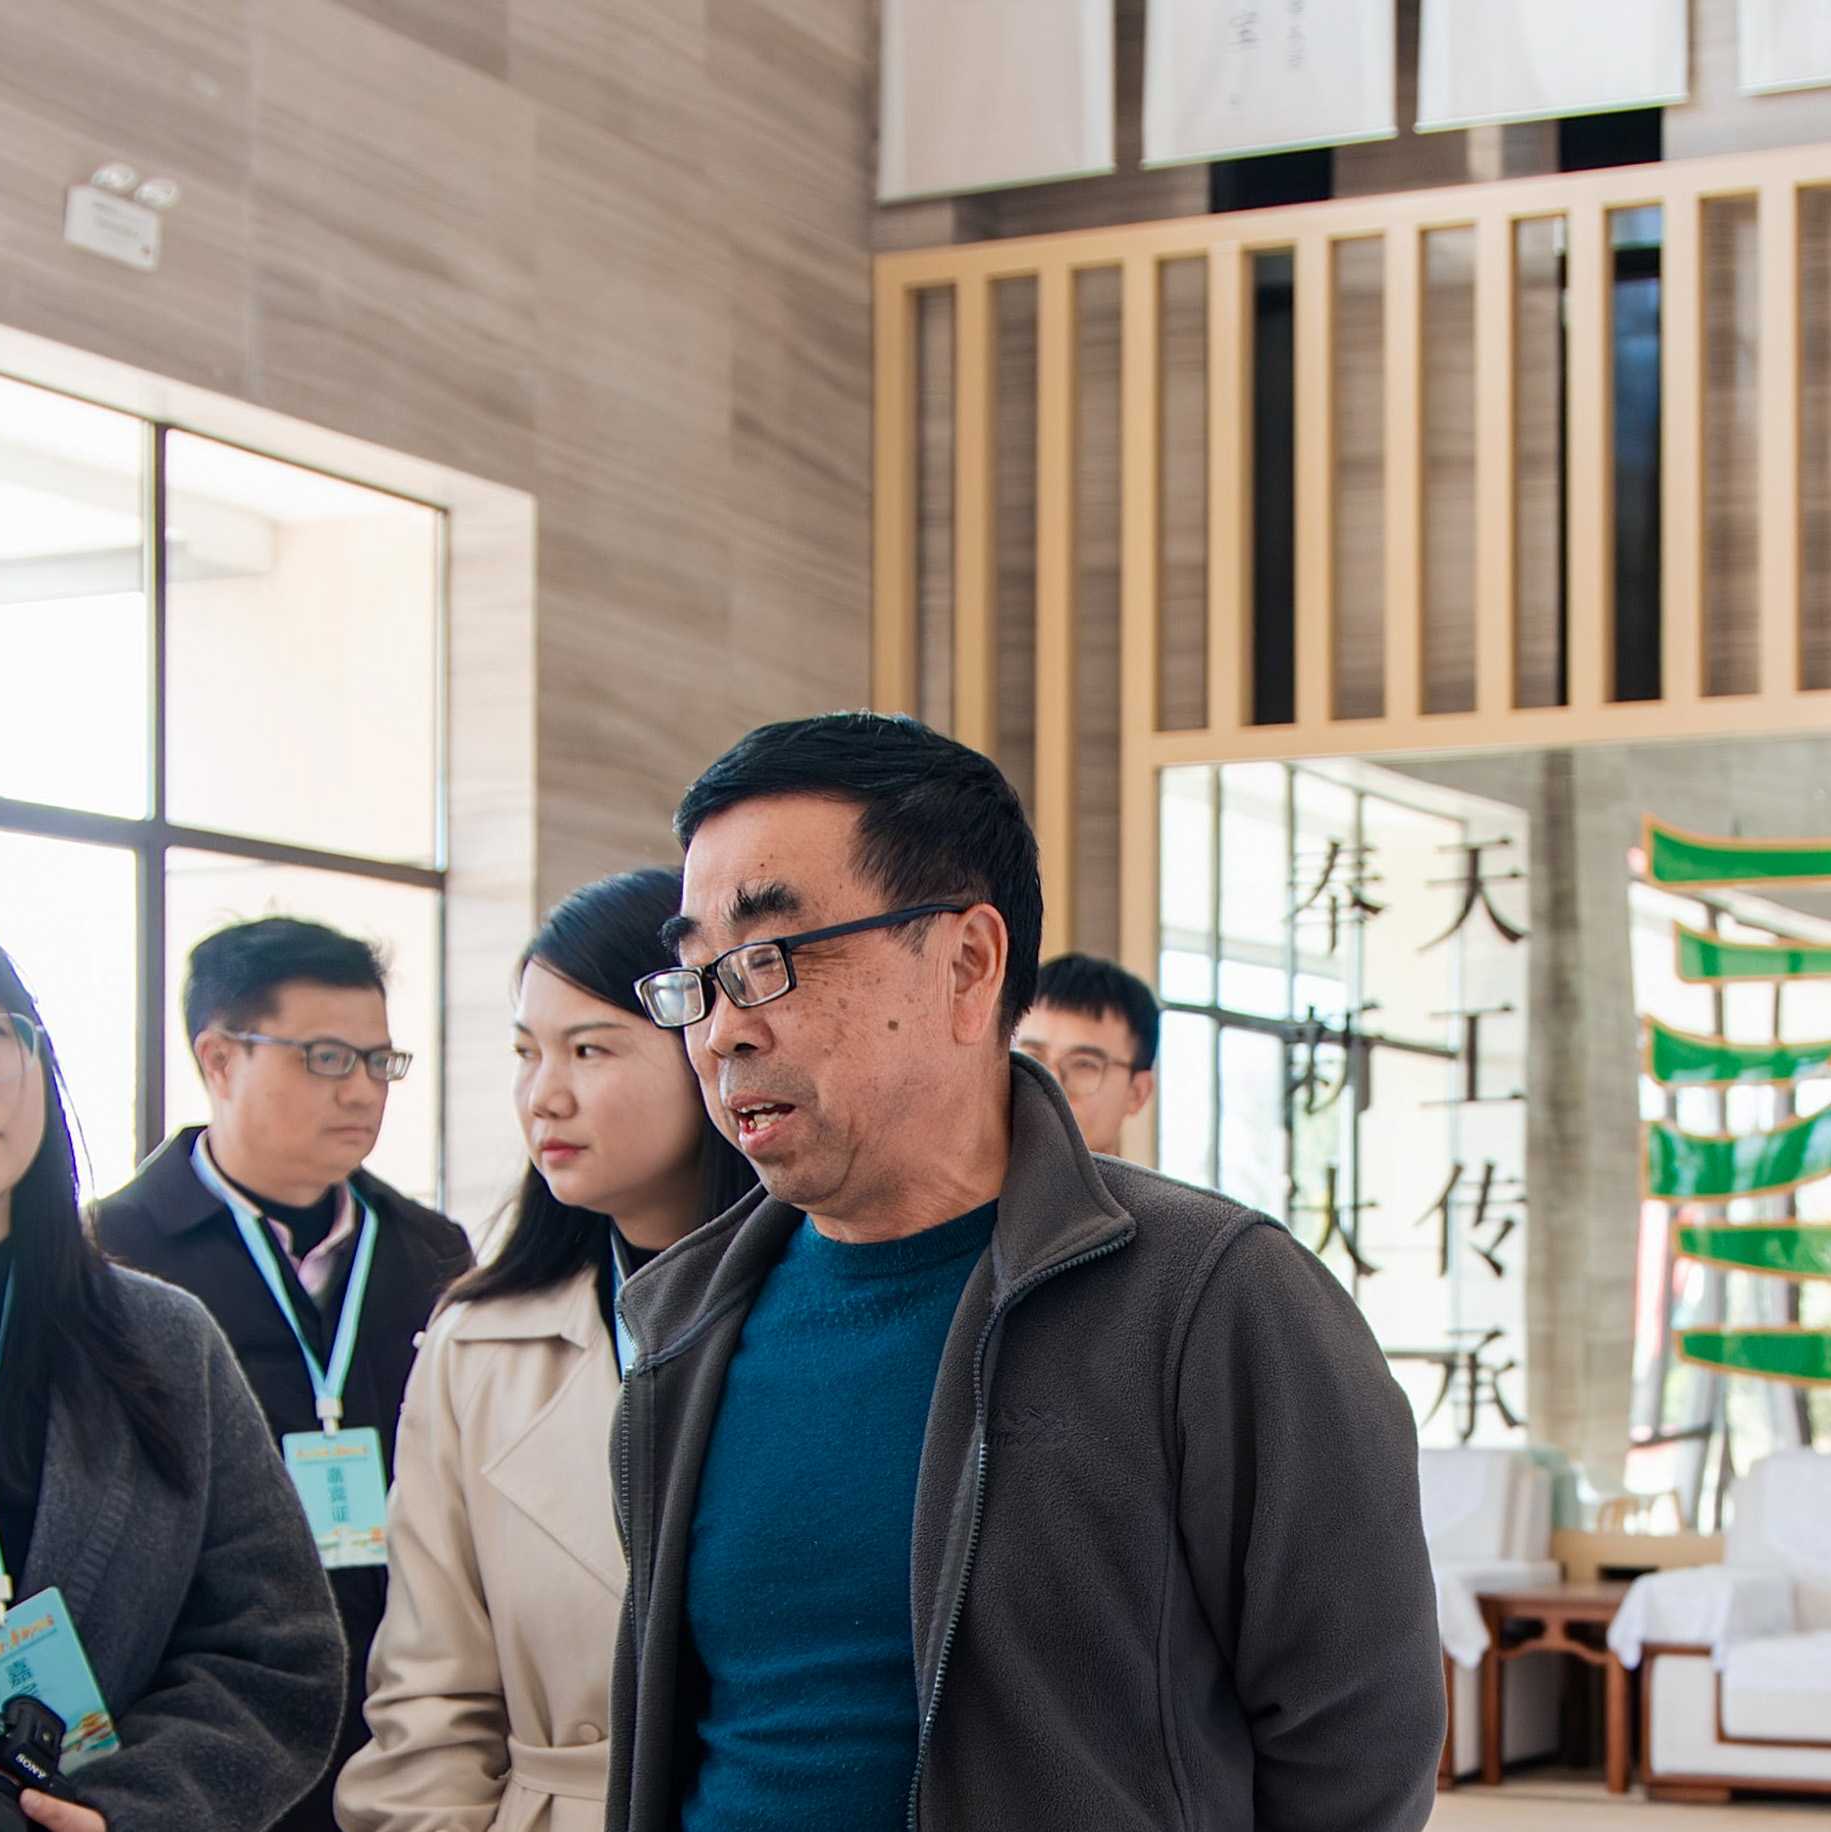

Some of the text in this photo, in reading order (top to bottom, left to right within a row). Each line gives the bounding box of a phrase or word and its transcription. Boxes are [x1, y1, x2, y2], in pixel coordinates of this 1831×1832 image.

[1414, 836, 1530, 1444] 天工传承
[15, 1753, 47, 1779] SONY
